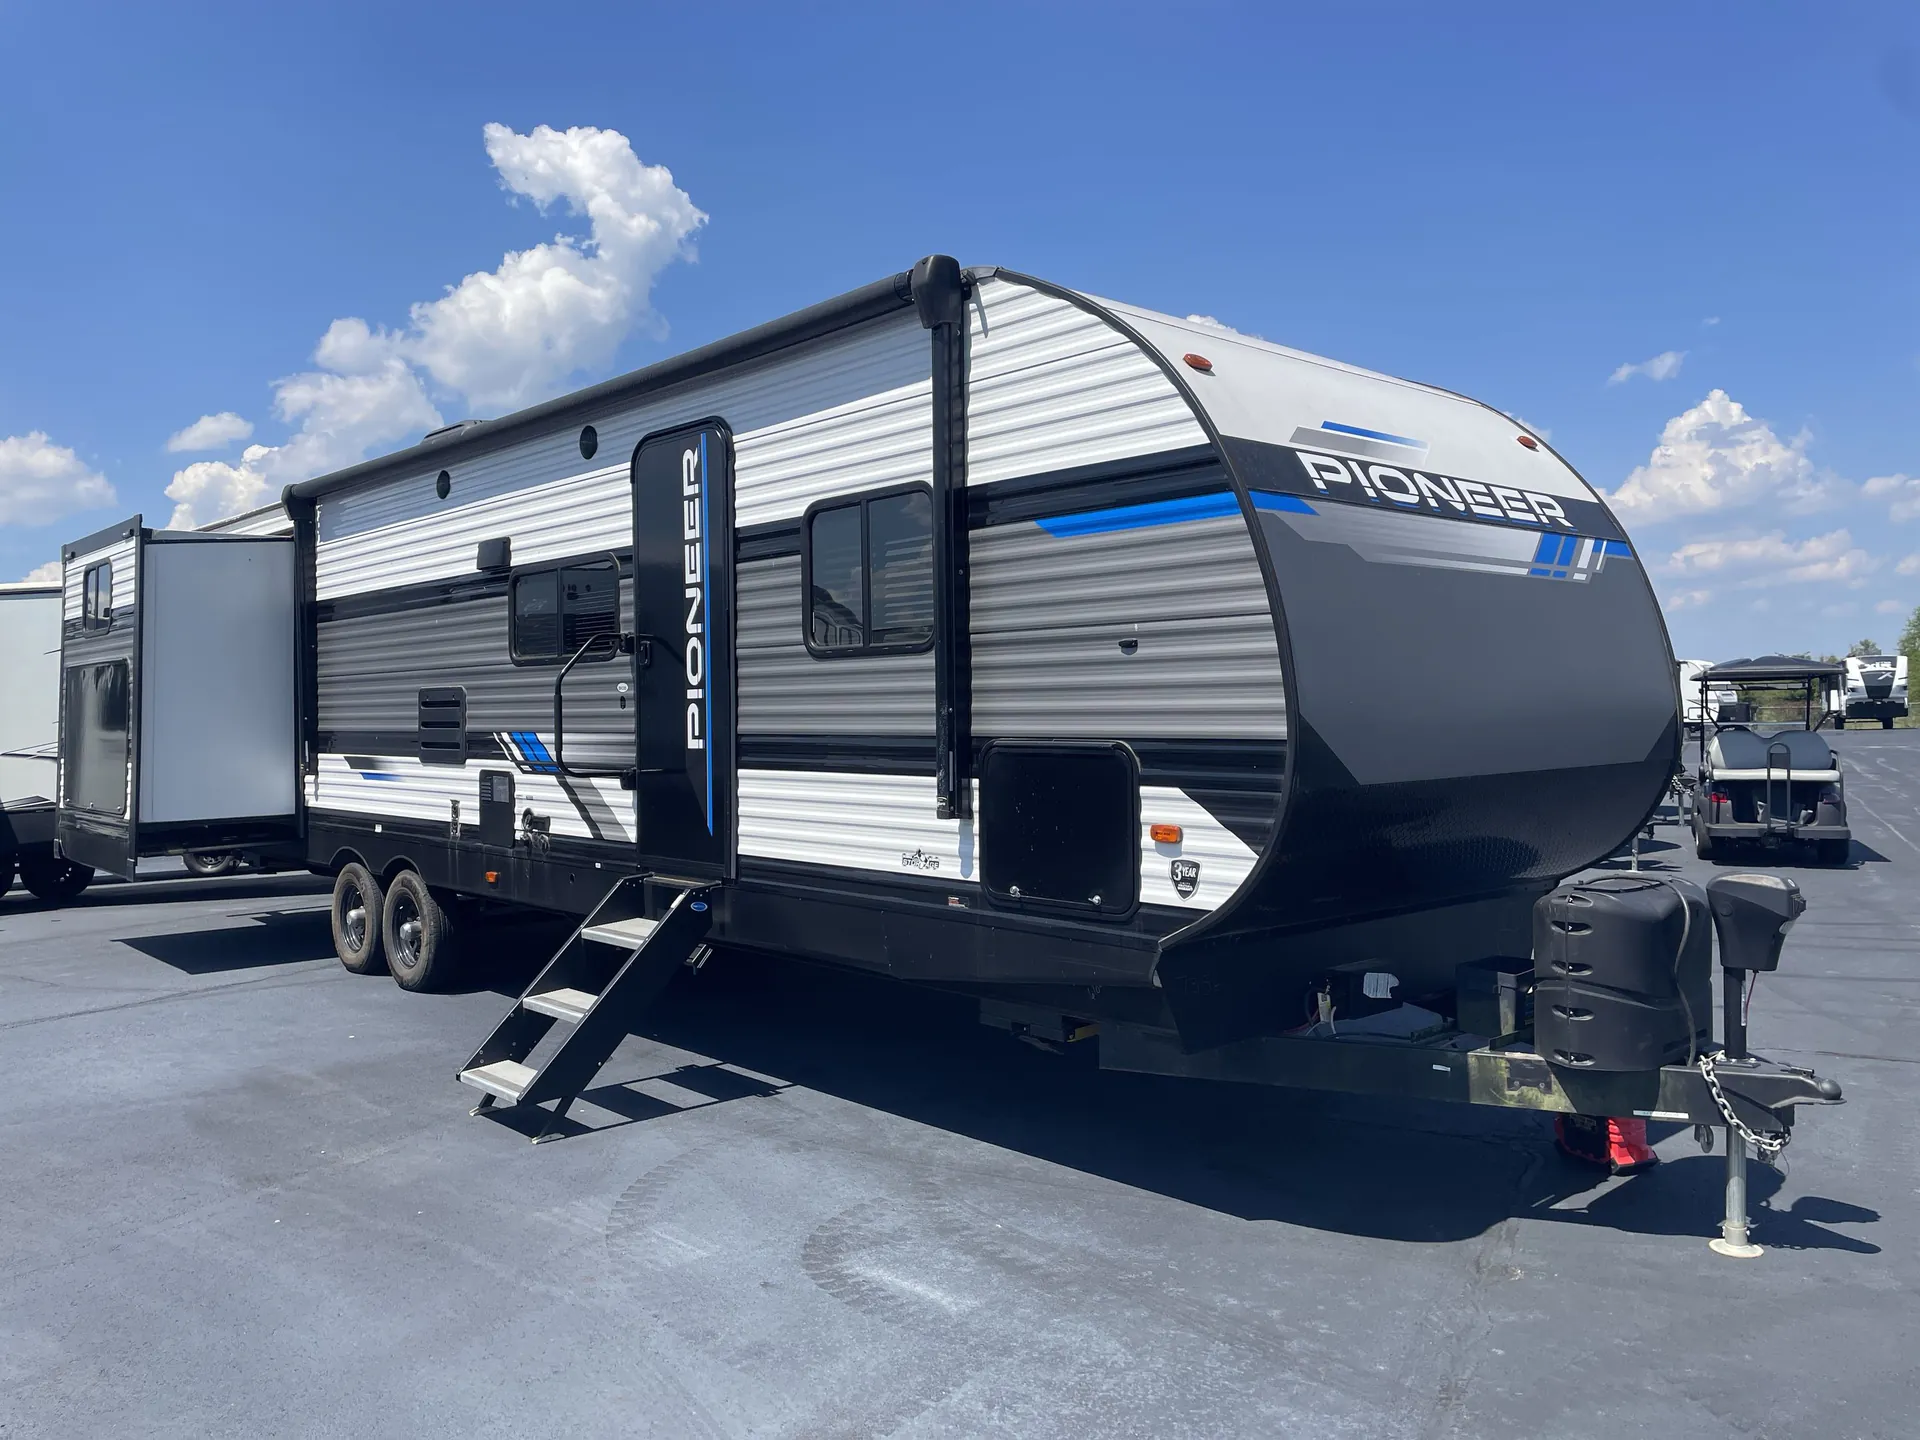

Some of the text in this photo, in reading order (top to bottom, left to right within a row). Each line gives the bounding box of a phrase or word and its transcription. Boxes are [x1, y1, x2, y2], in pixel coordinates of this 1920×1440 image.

[1296, 451, 1574, 528] PIONEER
[683, 447, 704, 750] PIONEER
[1173, 861, 1197, 881] 3 YEAR
